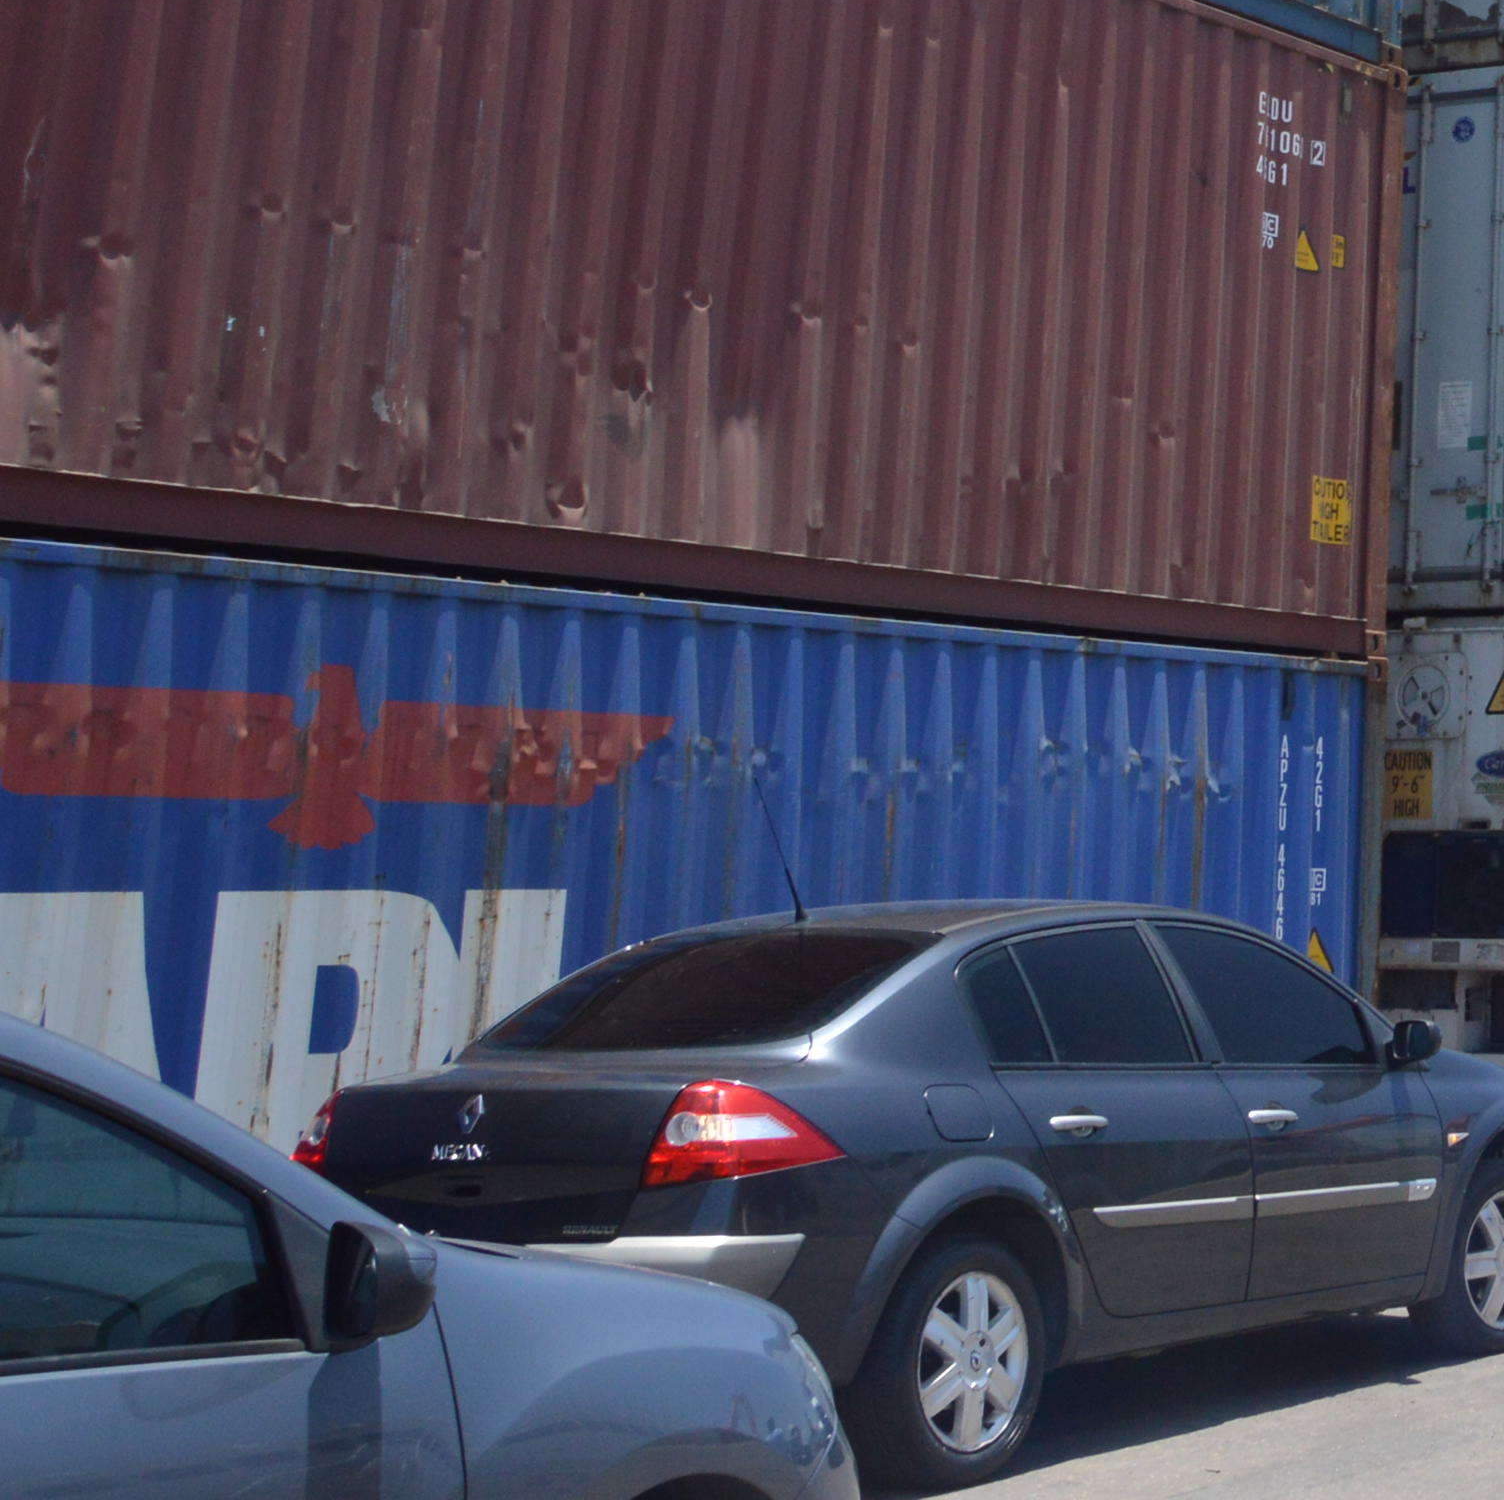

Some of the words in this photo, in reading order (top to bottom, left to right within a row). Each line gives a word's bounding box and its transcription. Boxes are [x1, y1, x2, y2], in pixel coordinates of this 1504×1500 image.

[1278, 734, 1289, 831] APZU
[1314, 736, 1324, 832] 42G1
[1384, 751, 1432, 771] CAUTION
[1394, 798, 1419, 818] HIGH
